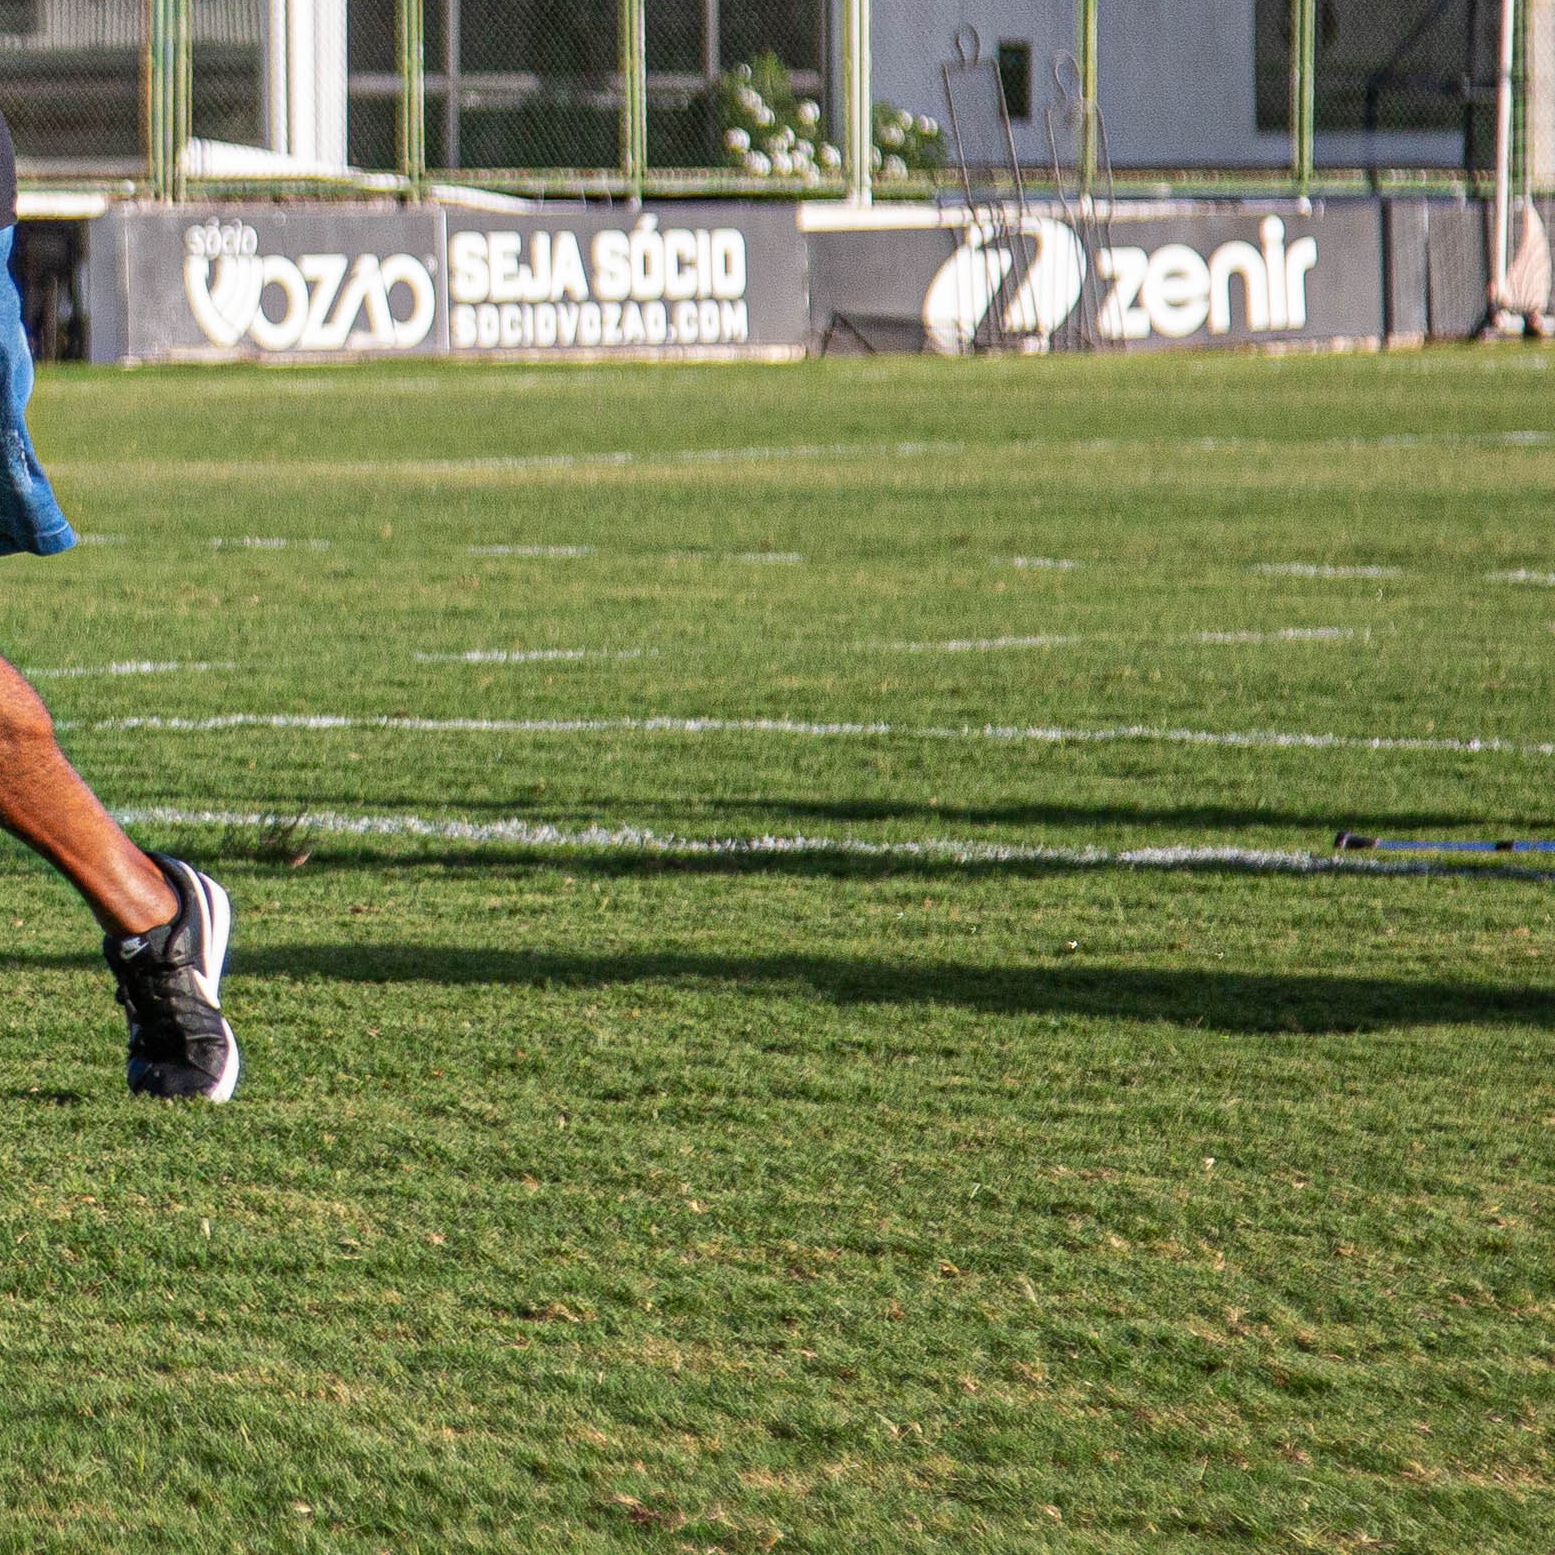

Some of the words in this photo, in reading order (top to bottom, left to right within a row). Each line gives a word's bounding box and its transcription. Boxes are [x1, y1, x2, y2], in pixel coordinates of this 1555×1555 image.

[449, 229, 589, 303] SEJA
[591, 212, 747, 302] SÓCIO
[1096, 213, 1318, 339] zenir
[450, 299, 749, 349] SOCIOVOZAO.COM
